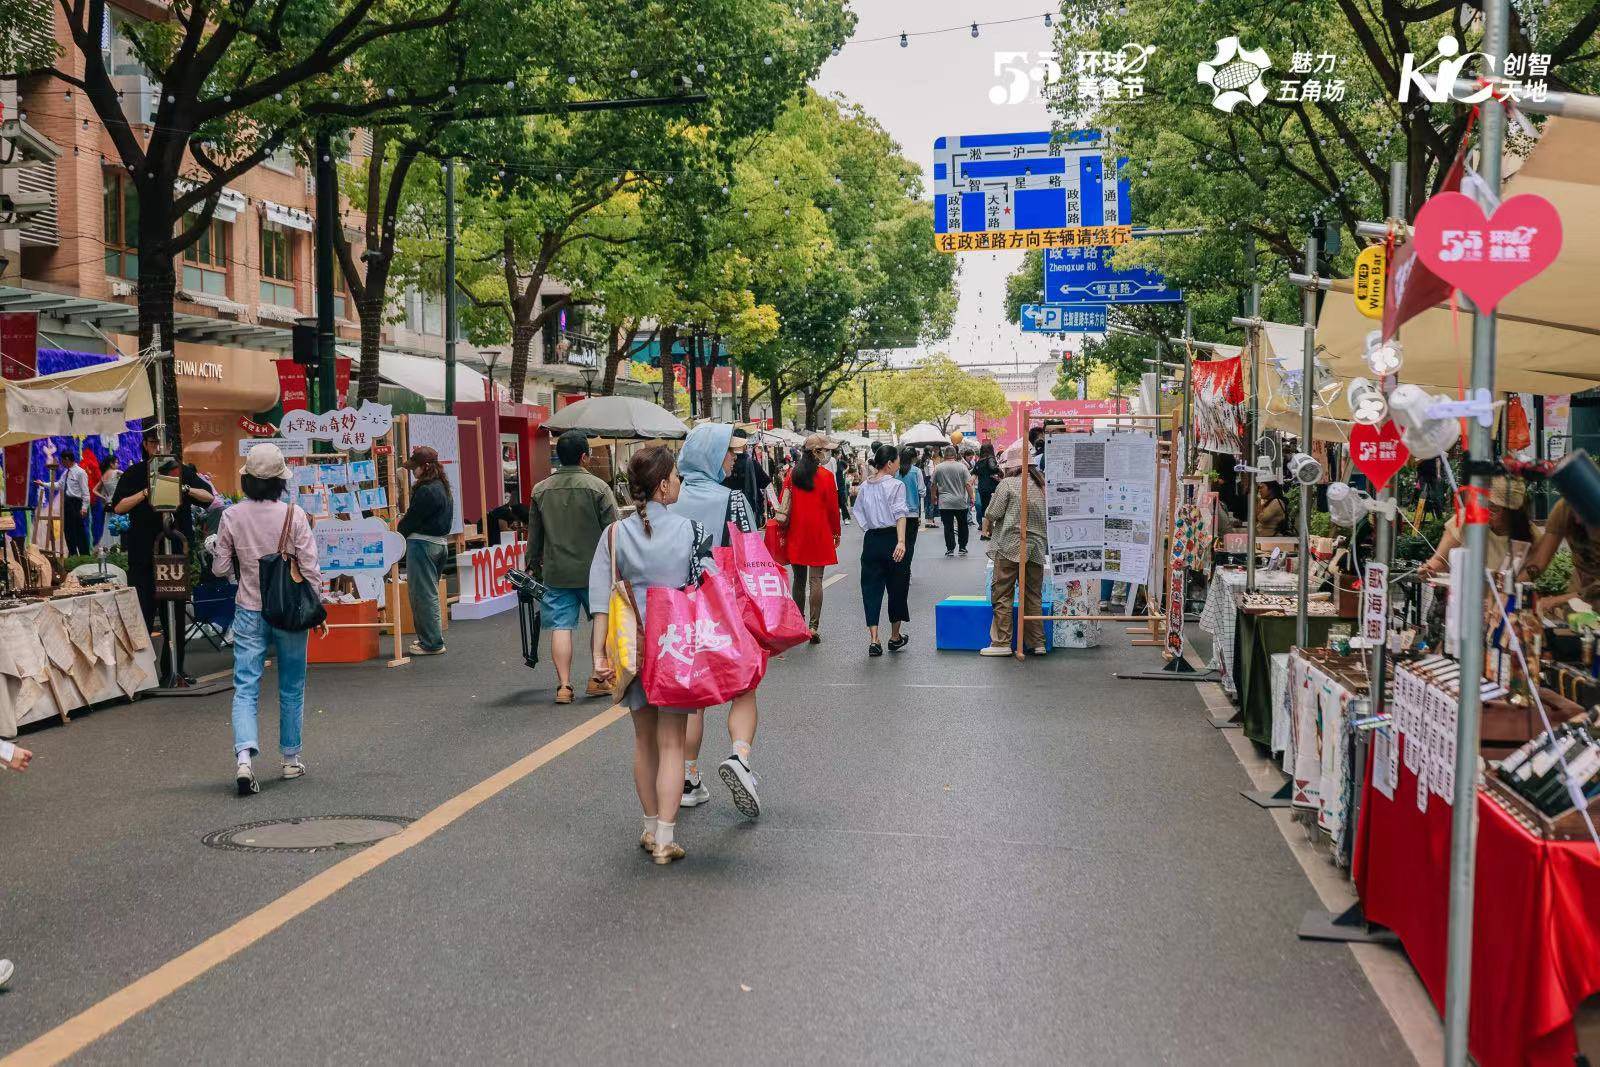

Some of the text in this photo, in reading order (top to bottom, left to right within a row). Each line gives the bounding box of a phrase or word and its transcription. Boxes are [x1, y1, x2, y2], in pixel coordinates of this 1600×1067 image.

[969, 175, 1062, 192] 智星路
[1104, 168, 1118, 222] 政通路
[948, 195, 961, 228] 政学路
[987, 194, 1000, 228] 大学路
[1067, 189, 1080, 224] 政民路
[941, 226, 1126, 250] 往政通路方向车辆请绕行
[1049, 247, 1098, 259] 政学路
[1049, 263, 1084, 272] Zhengxue
[1096, 283, 1131, 295] 智星路
[1370, 253, 1381, 310] Wine Bar
[199, 361, 223, 379] ACTIVE
[287, 413, 357, 433] 大学路的奇妙
[341, 431, 366, 445] 旅程
[156, 564, 184, 580] RU
